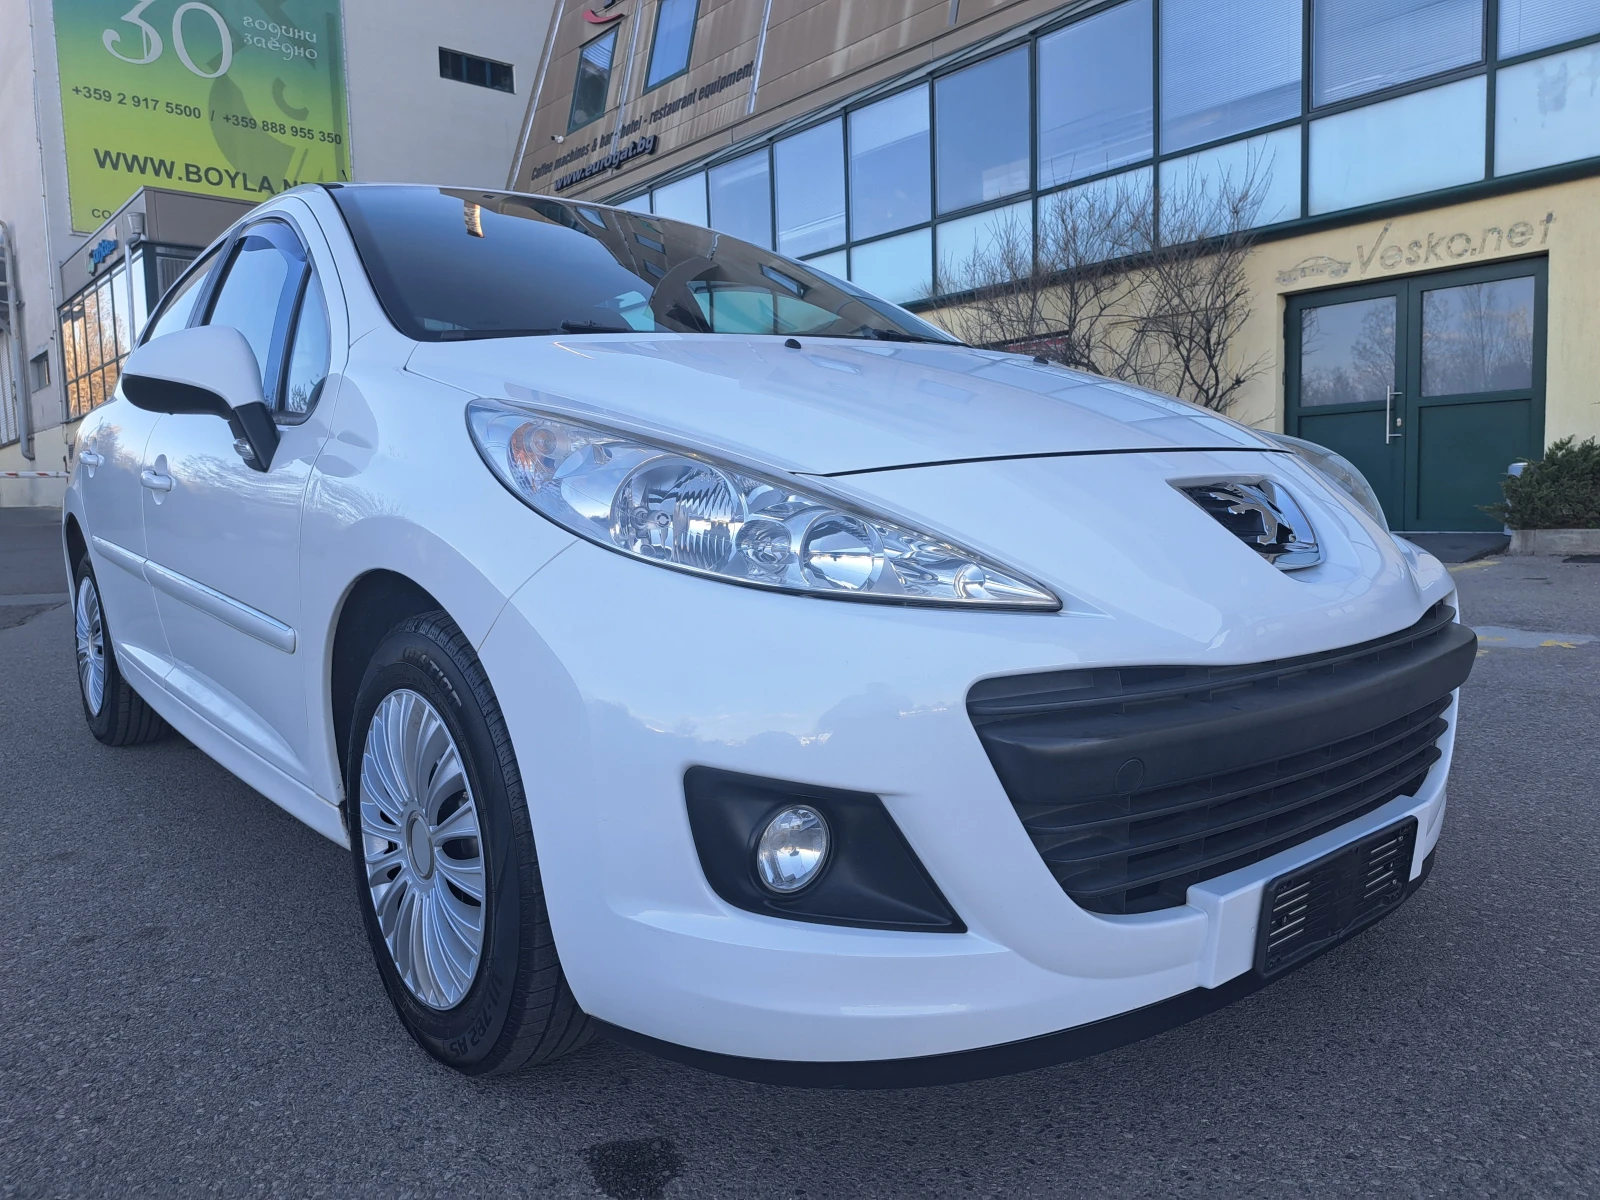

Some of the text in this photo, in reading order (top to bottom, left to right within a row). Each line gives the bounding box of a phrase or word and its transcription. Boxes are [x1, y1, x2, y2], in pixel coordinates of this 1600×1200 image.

[102, 0, 233, 78] 30
[72, 86, 342, 145] +359 2 917 5500 / +359 888 955 350
[531, 160, 554, 180] Coffee
[554, 142, 591, 171] machines
[591, 137, 598, 154] &
[600, 130, 615, 150] bar
[619, 114, 641, 141] hotel
[649, 87, 698, 126] restaurant
[699, 59, 754, 101] equipment
[554, 134, 658, 192] www.eurogat.bg
[1356, 211, 1557, 275] Vesko.net
